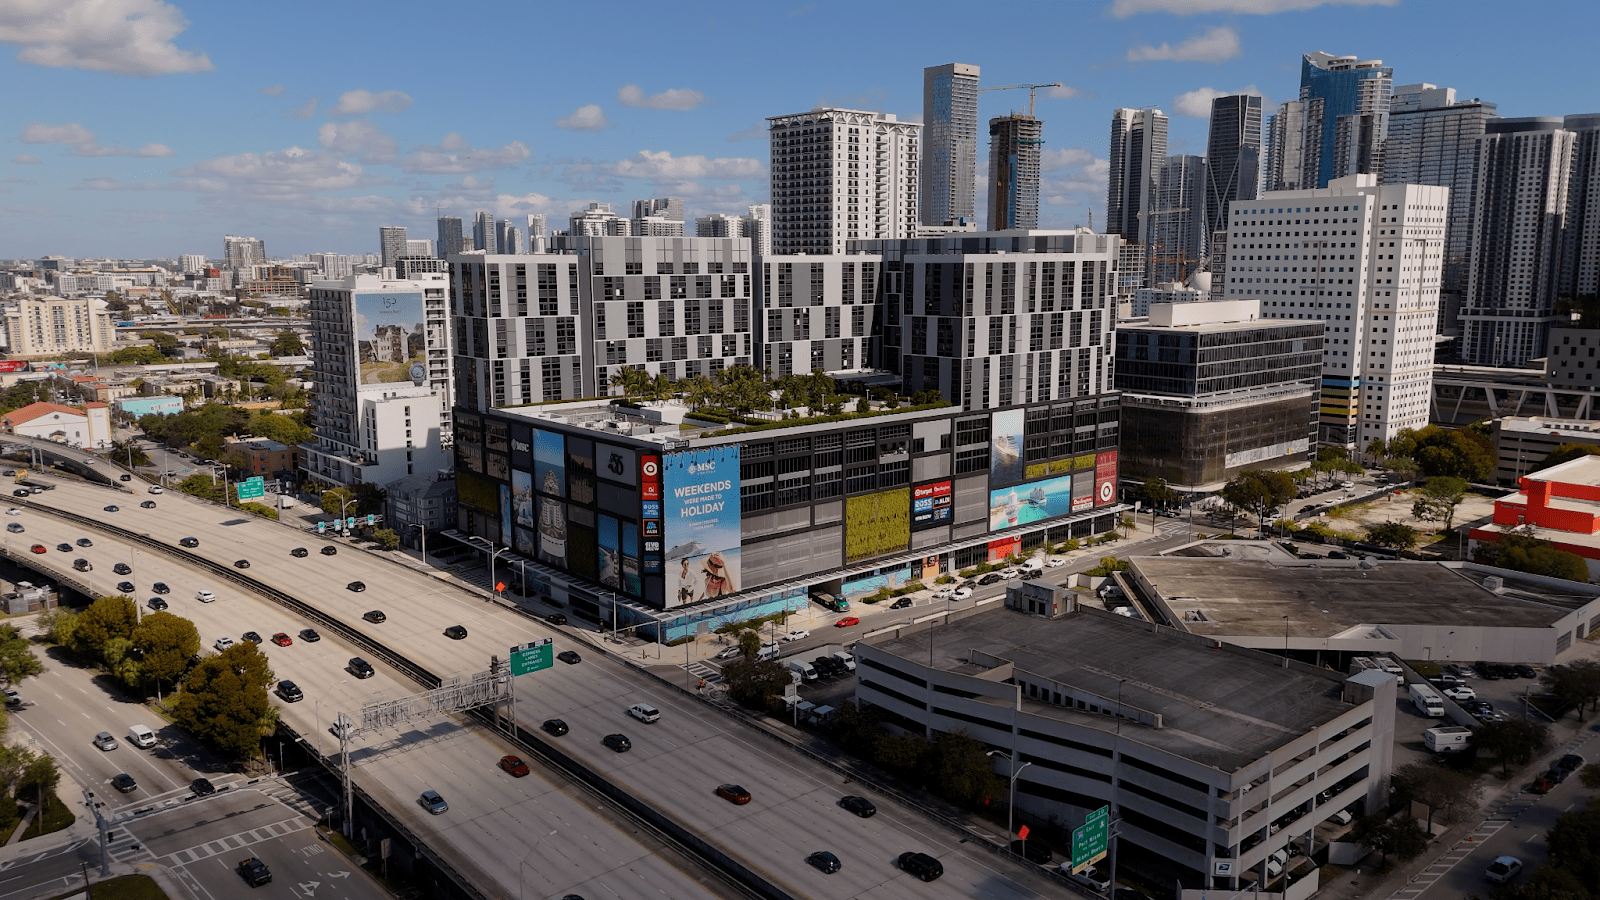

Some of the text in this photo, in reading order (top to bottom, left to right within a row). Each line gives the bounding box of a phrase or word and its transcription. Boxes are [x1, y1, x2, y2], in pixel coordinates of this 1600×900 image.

[516, 441, 530, 452] MSC
[697, 462, 716, 472] MSC
[674, 480, 732, 498] WEEKENDS
[915, 498, 932, 507] ROSS
[681, 501, 725, 517] HOLIDAY
[301, 844, 324, 857] ONLY
